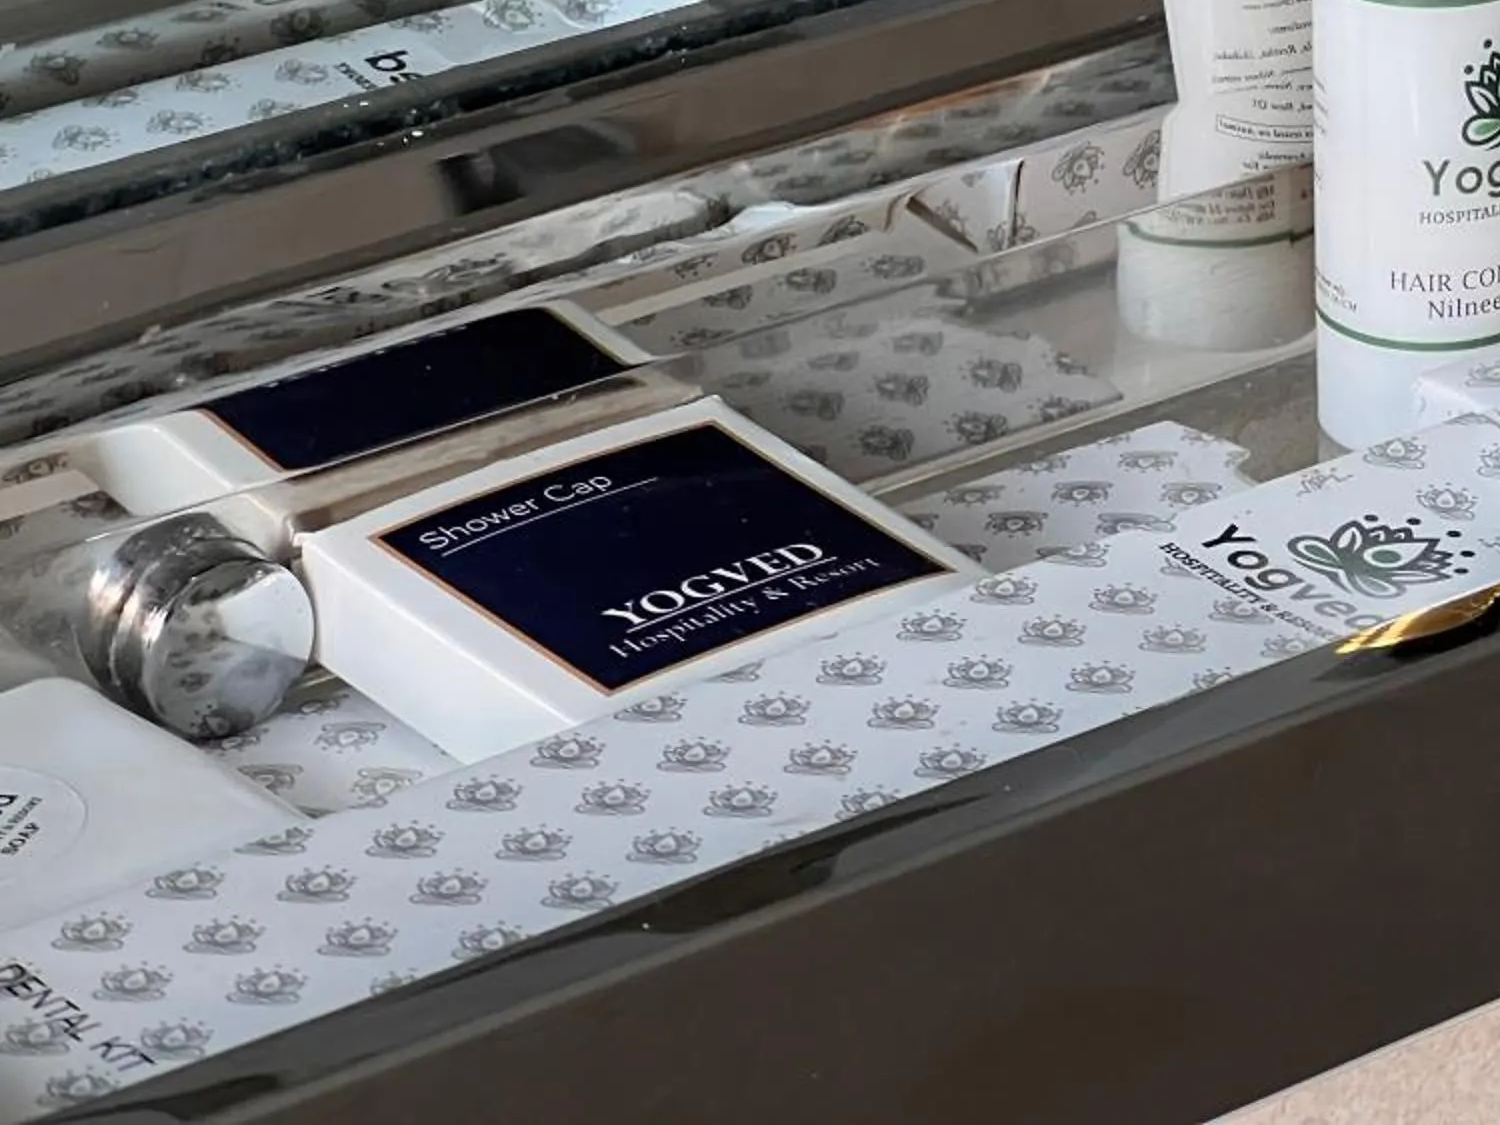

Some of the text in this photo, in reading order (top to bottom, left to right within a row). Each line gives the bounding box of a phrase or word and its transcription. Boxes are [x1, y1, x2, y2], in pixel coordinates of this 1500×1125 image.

[1390, 271, 1452, 293] HAIR
[418, 475, 613, 551] Shower Cap
[601, 542, 824, 626] YOGVED
[1158, 541, 1266, 605] HOSPITALITY
[609, 597, 760, 659] Hospitality
[761, 585, 790, 601] &
[0, 962, 158, 1073] DENTAL KIT
